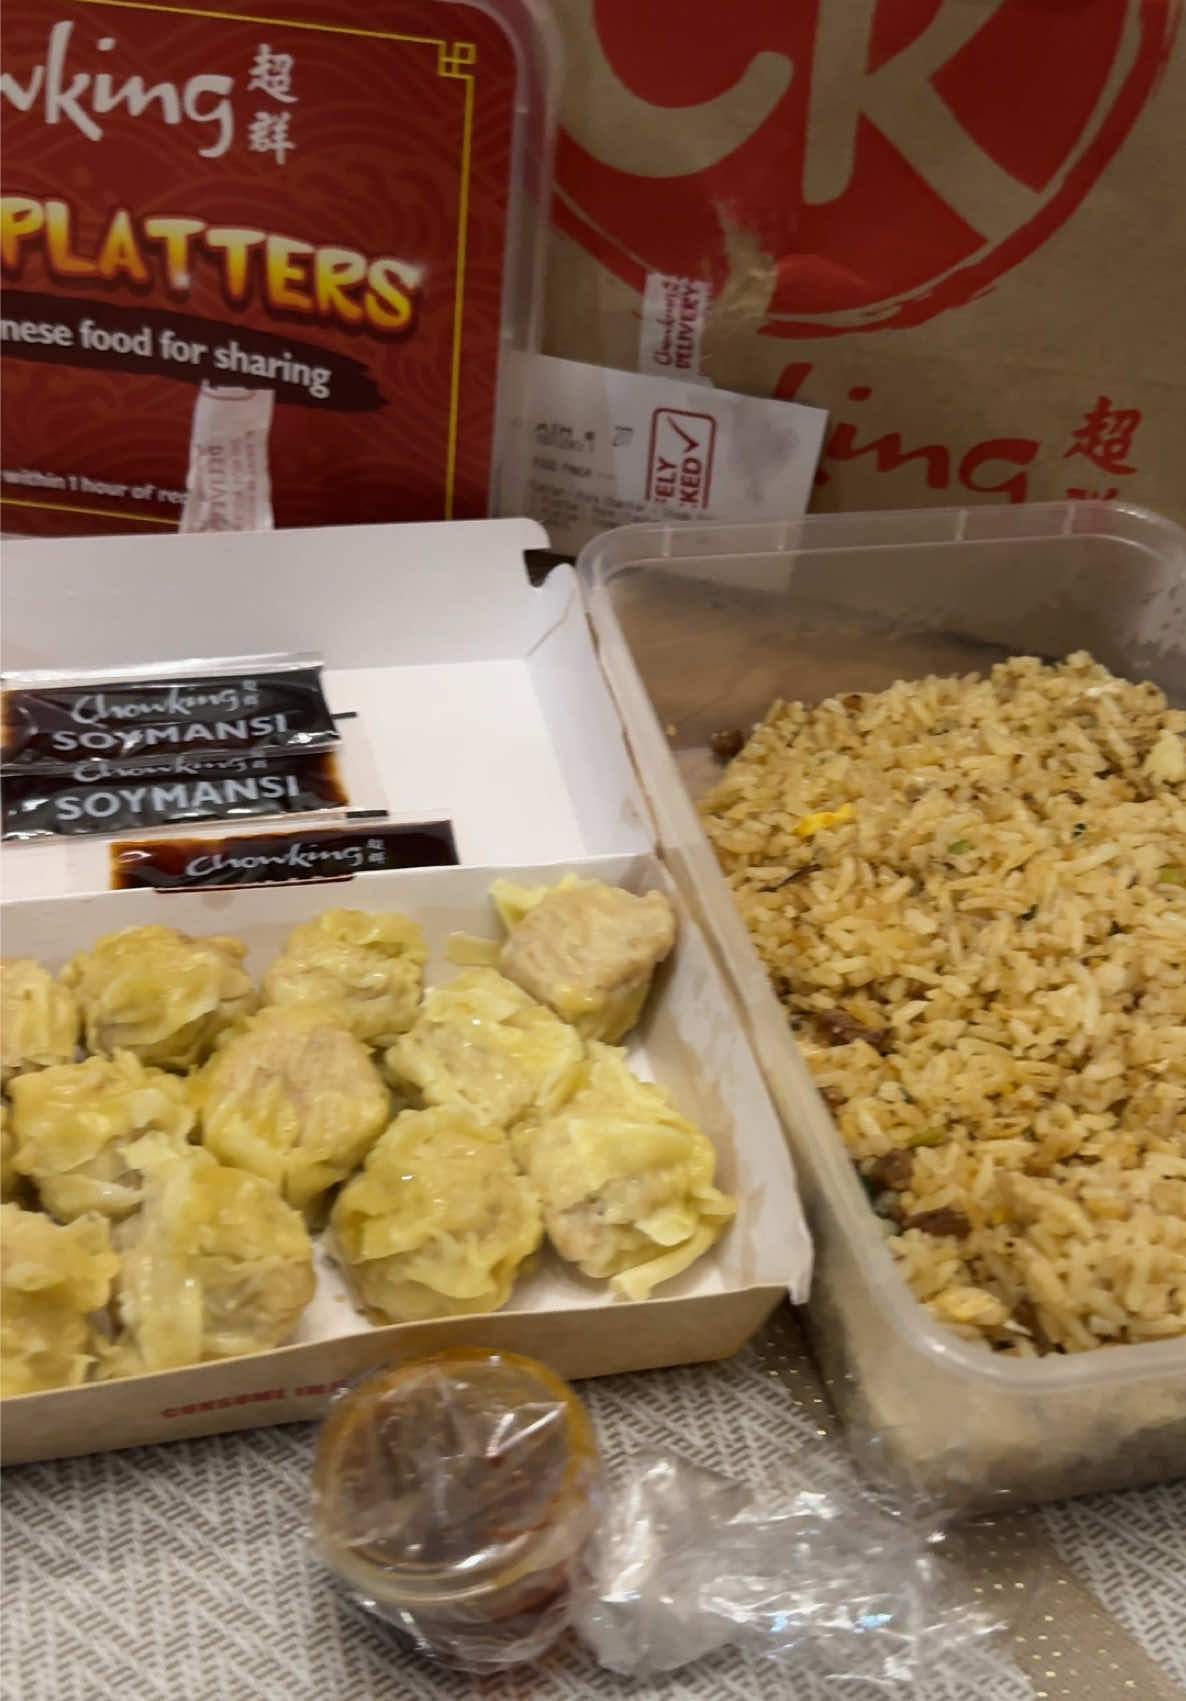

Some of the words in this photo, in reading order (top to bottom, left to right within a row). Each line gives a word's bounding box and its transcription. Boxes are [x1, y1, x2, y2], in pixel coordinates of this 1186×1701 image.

[0, 196, 425, 328] PLATTERS
[675, 284, 700, 370] DELIVERY
[0, 319, 74, 347] nese
[80, 318, 153, 359] food
[159, 332, 209, 366] for
[213, 341, 333, 400] sharing
[1063, 395, 1142, 501] 超
[2, 469, 66, 491] within
[69, 475, 78, 491] 1
[80, 475, 128, 497] hour
[131, 483, 157, 500] of
[655, 456, 677, 503] ELY
[680, 457, 703, 508] KED
[71, 686, 239, 729] Chowking
[53, 713, 288, 750] SOYMANSI
[55, 775, 300, 821] SOYMANSI
[185, 842, 364, 877] Chowking
